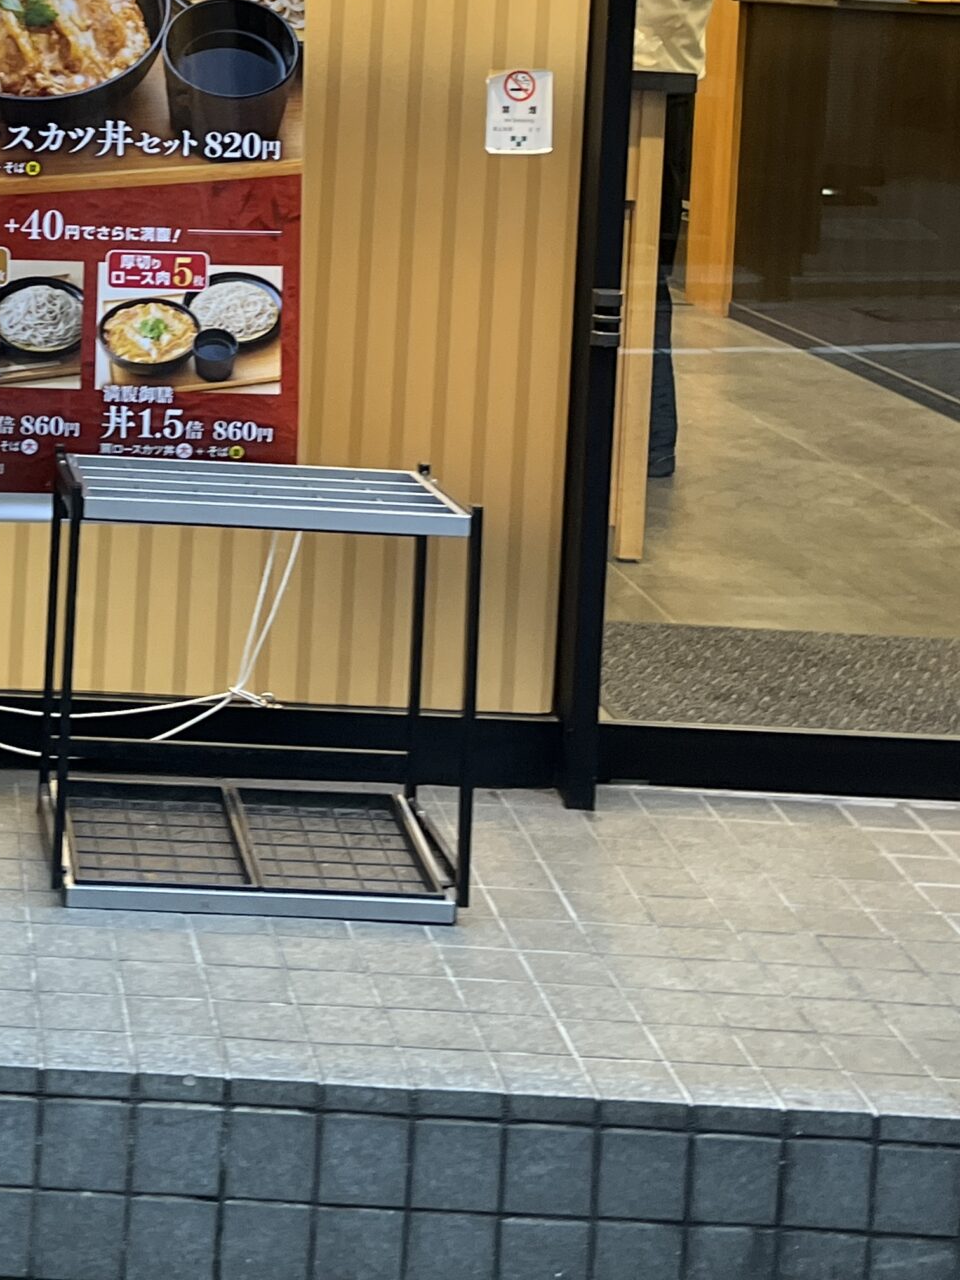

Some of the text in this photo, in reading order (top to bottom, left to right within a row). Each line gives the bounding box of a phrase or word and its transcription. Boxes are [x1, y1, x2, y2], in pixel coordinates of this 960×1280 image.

[203, 130, 282, 161] 820円
[19, 415, 81, 437] 860円
[100, 405, 274, 442] 丼1.5倍 860円
